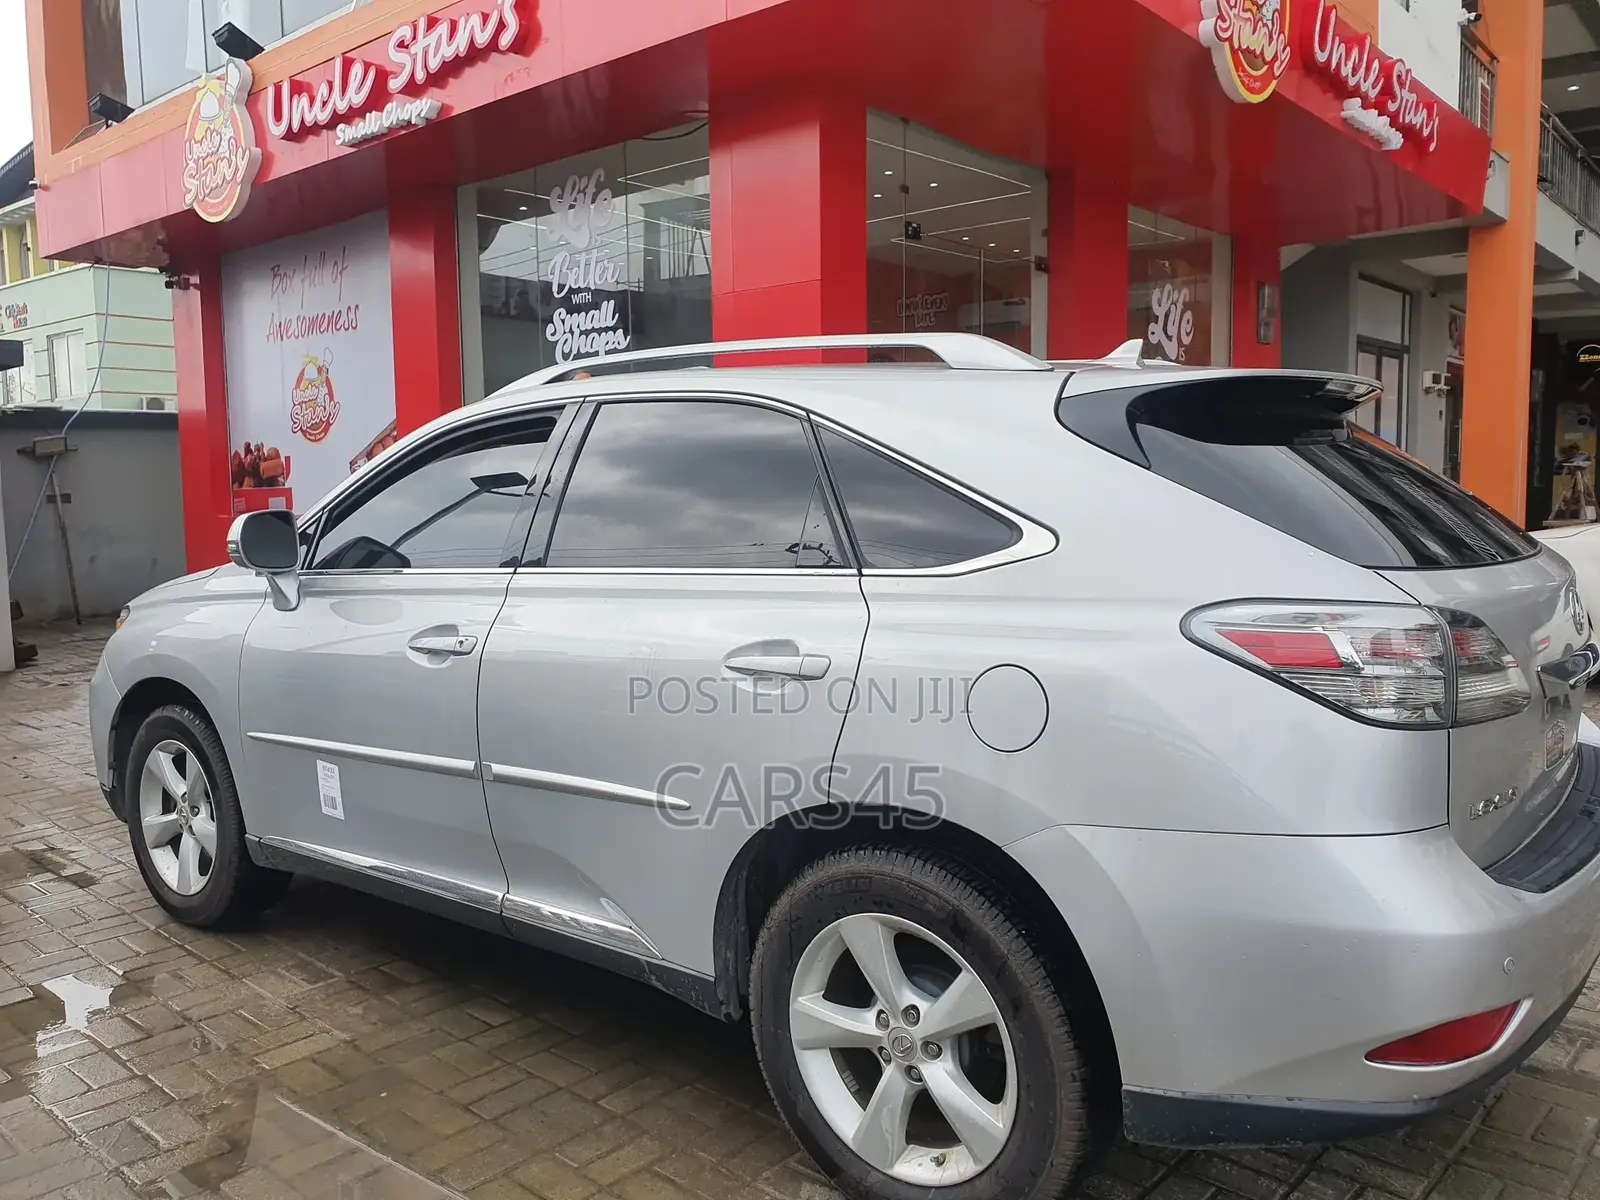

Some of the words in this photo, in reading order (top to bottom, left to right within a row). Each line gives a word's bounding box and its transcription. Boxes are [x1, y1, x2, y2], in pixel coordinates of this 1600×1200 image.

[267, 54, 376, 138] Uncle
[1314, 0, 1384, 101] Uncle
[1387, 60, 1439, 153] Stan's
[184, 127, 222, 164] Uncle
[335, 112, 380, 146] Small
[382, 97, 433, 127] Chops
[548, 168, 613, 249] Life
[269, 264, 296, 299] Box
[301, 254, 325, 310] full
[331, 246, 349, 303] of
[548, 249, 620, 298] Better
[571, 291, 592, 304] WITH
[266, 304, 360, 344] Awesomeness
[545, 299, 619, 342] Small
[1147, 283, 1194, 360] Life
[555, 326, 630, 365] Chops
